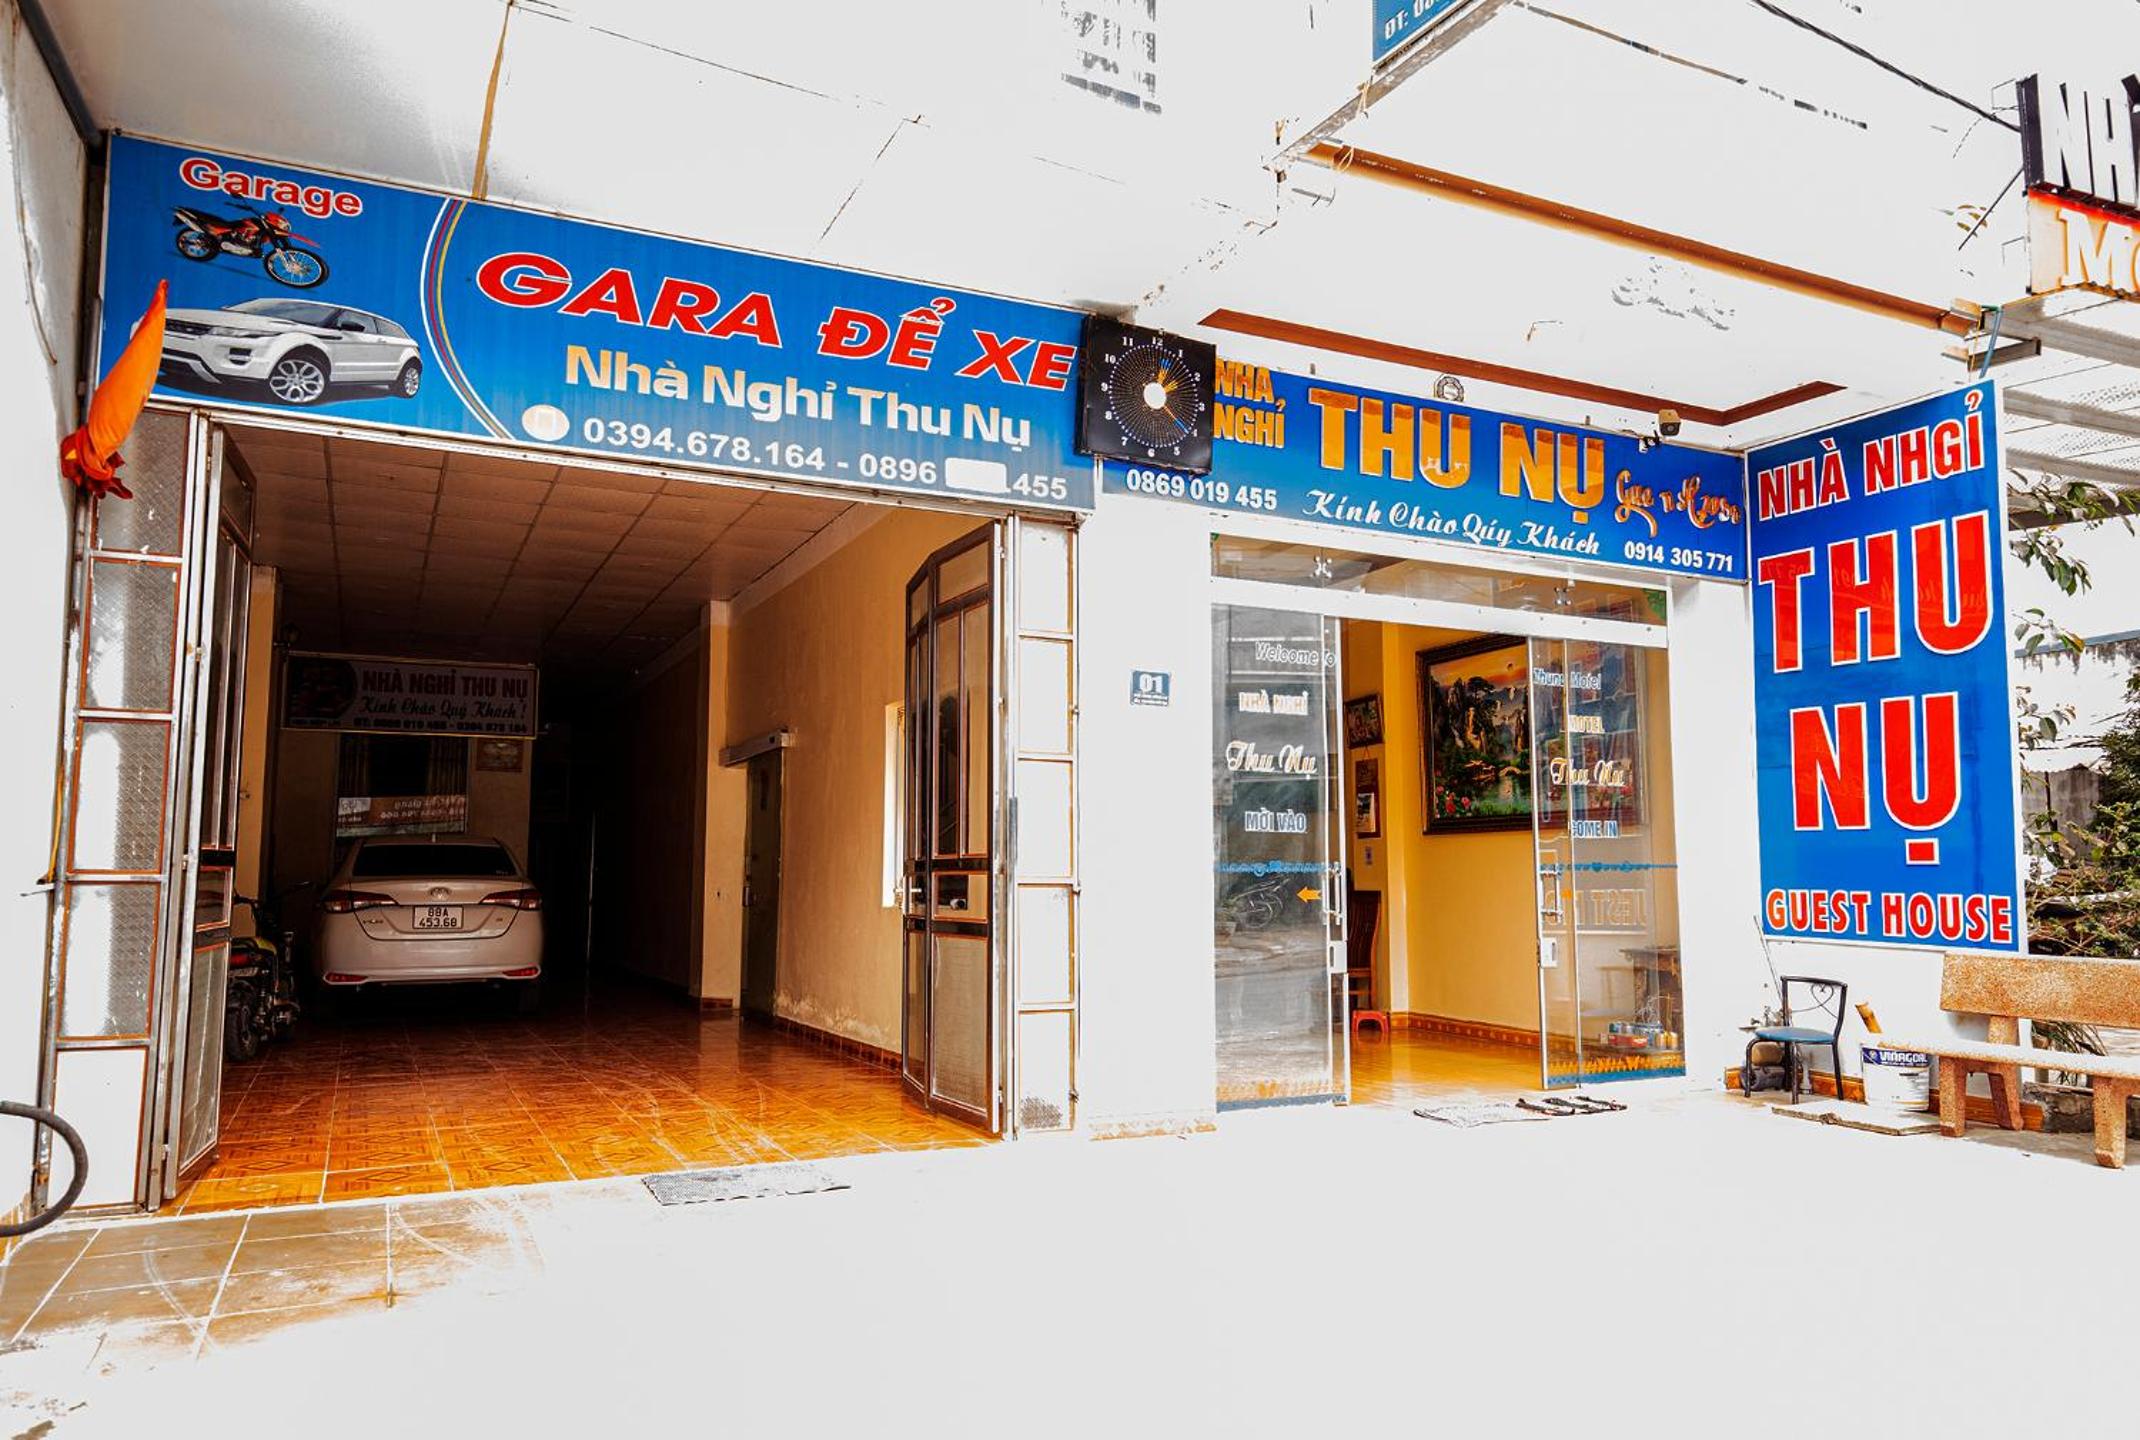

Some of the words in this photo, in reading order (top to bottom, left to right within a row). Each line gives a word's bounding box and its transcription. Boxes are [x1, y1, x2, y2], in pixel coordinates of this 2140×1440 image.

[179, 157, 363, 219] Garage
[476, 251, 783, 348] GARA
[817, 296, 956, 371] ĐỂ
[955, 329, 1078, 391] XE
[565, 344, 689, 401] Nhà
[703, 365, 837, 422] Nghỉ
[847, 386, 950, 437] Thu
[963, 405, 1031, 453] Nụ
[584, 418, 826, 471] 0394.678.164
[859, 453, 937, 484] 0896
[1309, 387, 1470, 488] THU
[1500, 423, 1605, 525] NỤ
[1758, 439, 1849, 521] NHÀ
[1864, 390, 1985, 497] NHGỈ
[1126, 469, 1185, 497] 0869
[1190, 479, 1229, 503] 019
[1235, 485, 1278, 510] 455
[1302, 489, 1382, 525] Kính
[1388, 501, 1458, 535] Chào
[1517, 521, 1600, 556] Khách
[1624, 540, 1665, 564] 0914
[1670, 547, 1703, 568] 305
[1706, 552, 1733, 572] 771
[1758, 510, 1993, 674] THU
[1139, 673, 1163, 692] 01
[1255, 641, 1319, 666] Welcome
[1226, 740, 1275, 772] Thu
[1789, 692, 1961, 865] NỤ
[1245, 806, 1275, 832] MỜI
[1276, 808, 1307, 833] VÀO
[1766, 889, 1871, 936] GUEST
[1882, 893, 2012, 943] HOUSE
